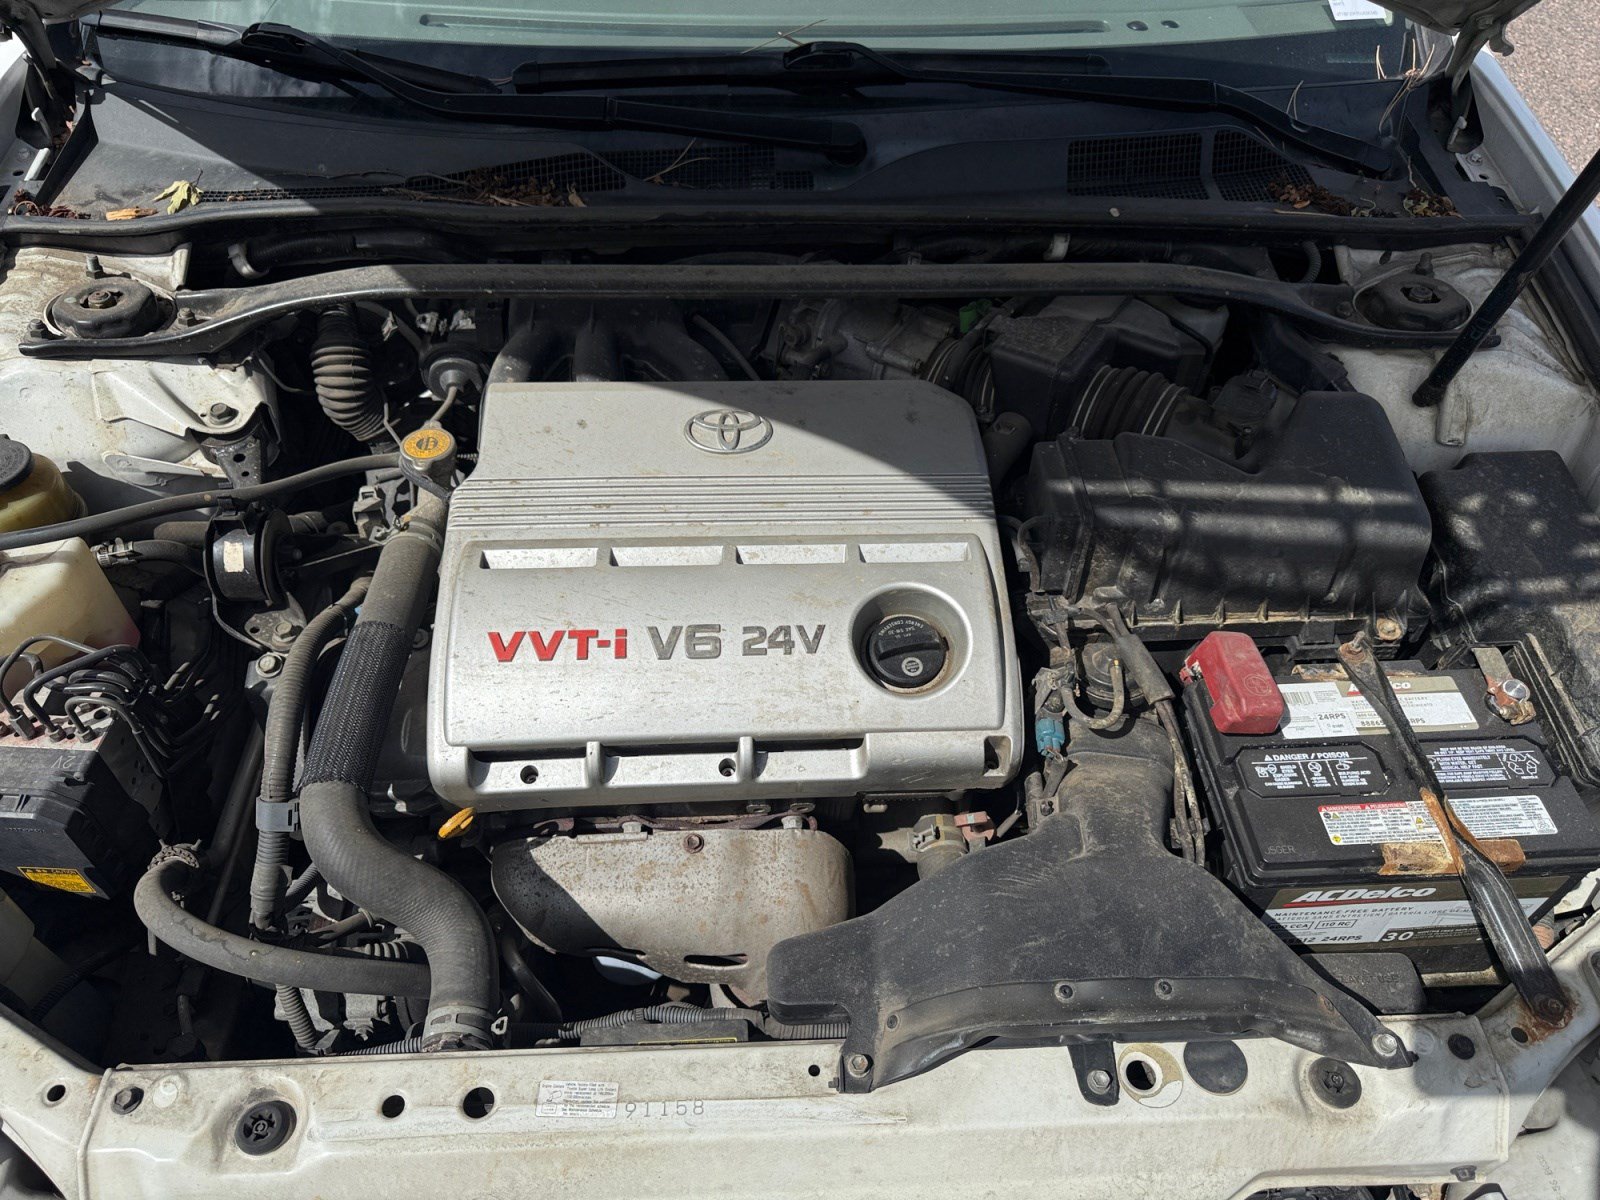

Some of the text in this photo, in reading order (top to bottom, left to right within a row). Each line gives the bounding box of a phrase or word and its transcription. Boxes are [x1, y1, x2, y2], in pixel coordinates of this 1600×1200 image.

[488, 624, 826, 662] VVT-i V6 24V
[1291, 886, 1436, 903] ACDelco
[1382, 931, 1414, 942] 30
[625, 1099, 705, 1119] 91158
